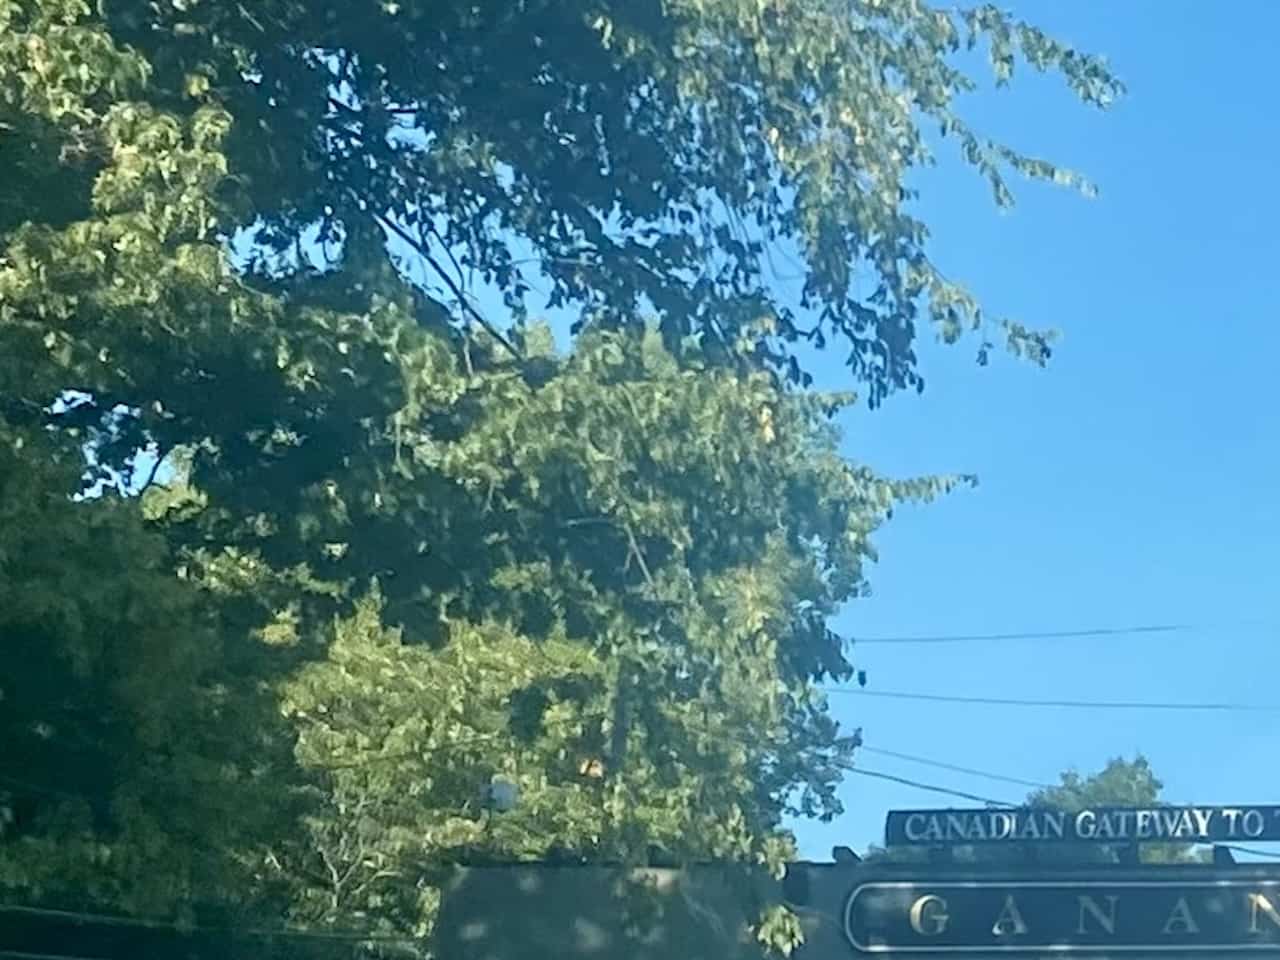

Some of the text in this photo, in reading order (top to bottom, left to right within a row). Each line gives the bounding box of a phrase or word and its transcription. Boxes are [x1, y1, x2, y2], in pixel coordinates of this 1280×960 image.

[904, 812, 1065, 842] CANADIAN
[1075, 809, 1210, 839] GATEWAY
[1222, 808, 1265, 837] TO
